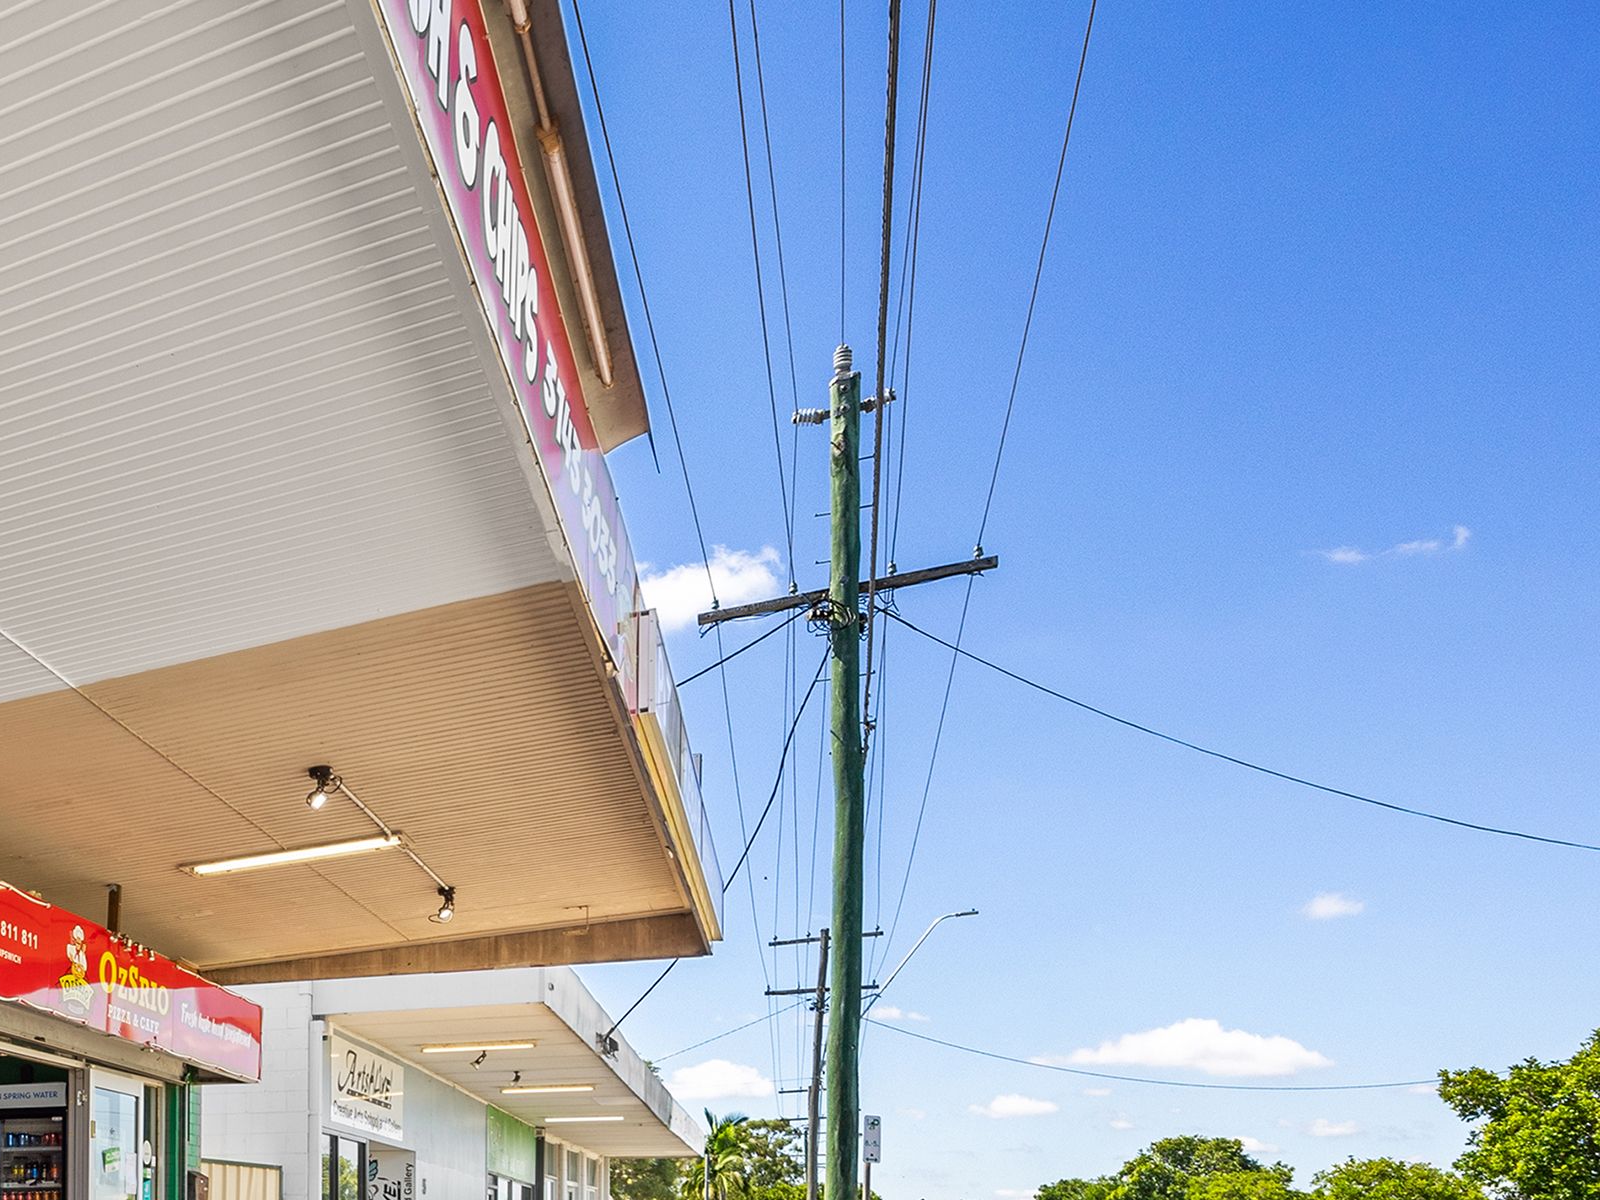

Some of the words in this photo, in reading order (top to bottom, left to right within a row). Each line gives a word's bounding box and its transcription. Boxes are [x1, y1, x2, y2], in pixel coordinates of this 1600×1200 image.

[482, 119, 538, 384] CHIPS
[543, 339, 582, 496] 3143
[0, 920, 18, 942] 811
[21, 929, 38, 950] 811
[0, 948, 22, 965] IPSWICH
[108, 1004, 132, 1025] PIZZA
[133, 1014, 140, 1027] &
[180, 1002, 197, 1029] Fresh
[3, 1092, 31, 1100] SPRING
[33, 1090, 58, 1098] WATER
[403, 1163, 414, 1195] Gallery
